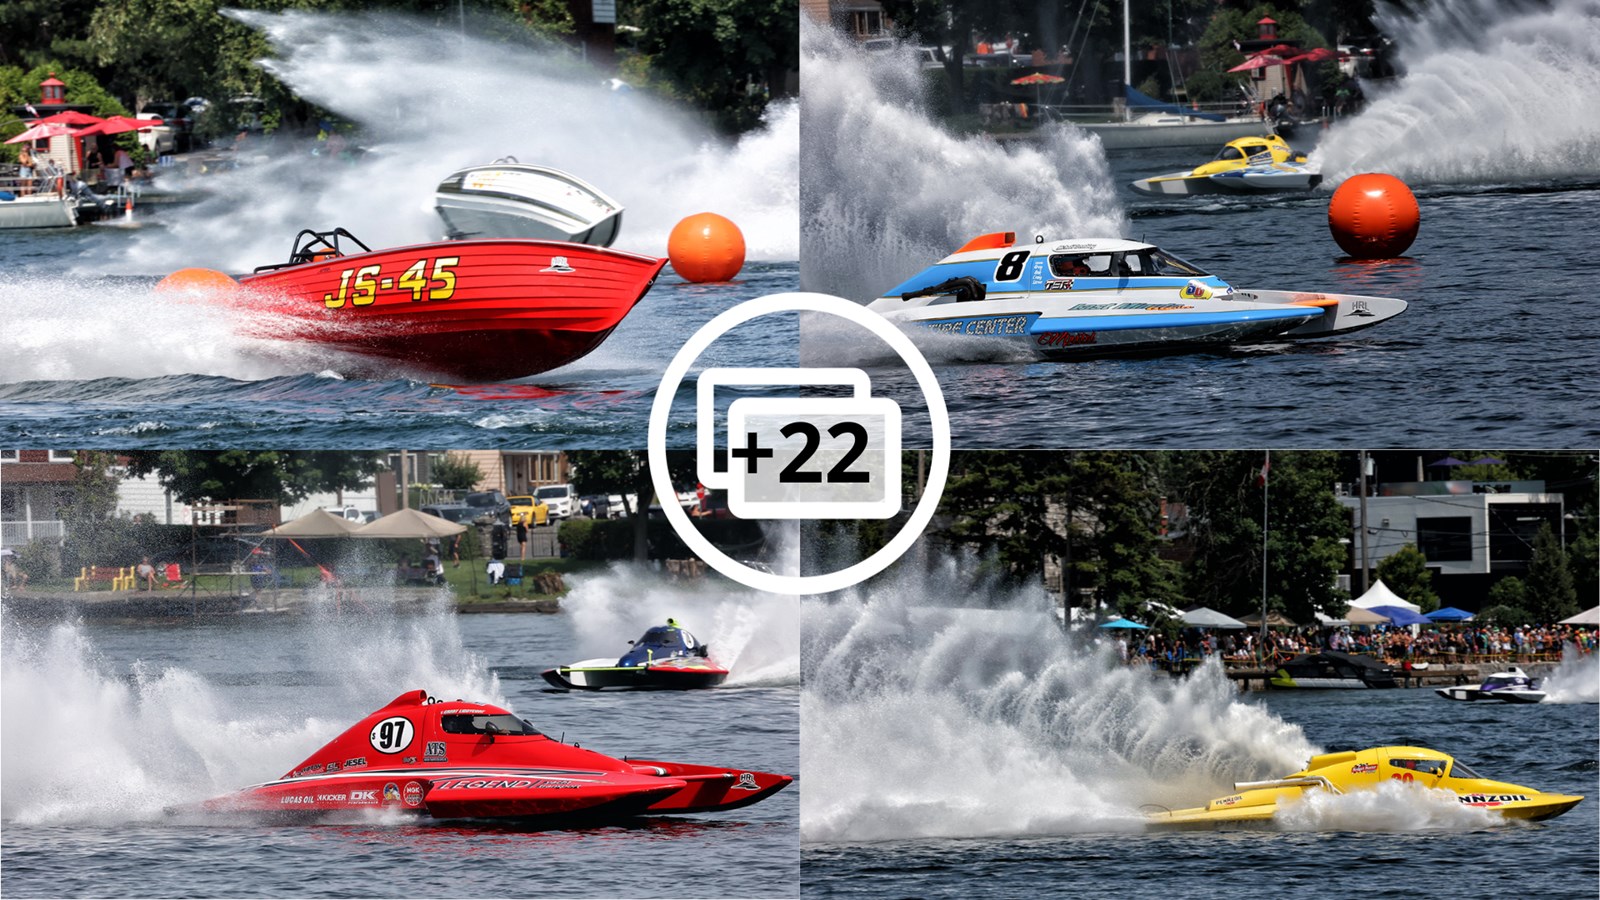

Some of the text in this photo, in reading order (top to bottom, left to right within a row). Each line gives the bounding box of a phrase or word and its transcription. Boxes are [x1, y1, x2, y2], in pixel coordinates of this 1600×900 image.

[996, 251, 1030, 281] 8
[324, 256, 460, 309] JS-45
[1351, 300, 1370, 311] HRL
[964, 316, 1027, 335] CENTER
[379, 720, 406, 749] 97
[425, 742, 446, 756] ATS
[344, 757, 367, 767] JESEL
[436, 780, 531, 790] LEGEND
[281, 796, 303, 804] LUCAS
[321, 794, 347, 802] KICKER
[1458, 795, 1531, 804] NNZOIL
